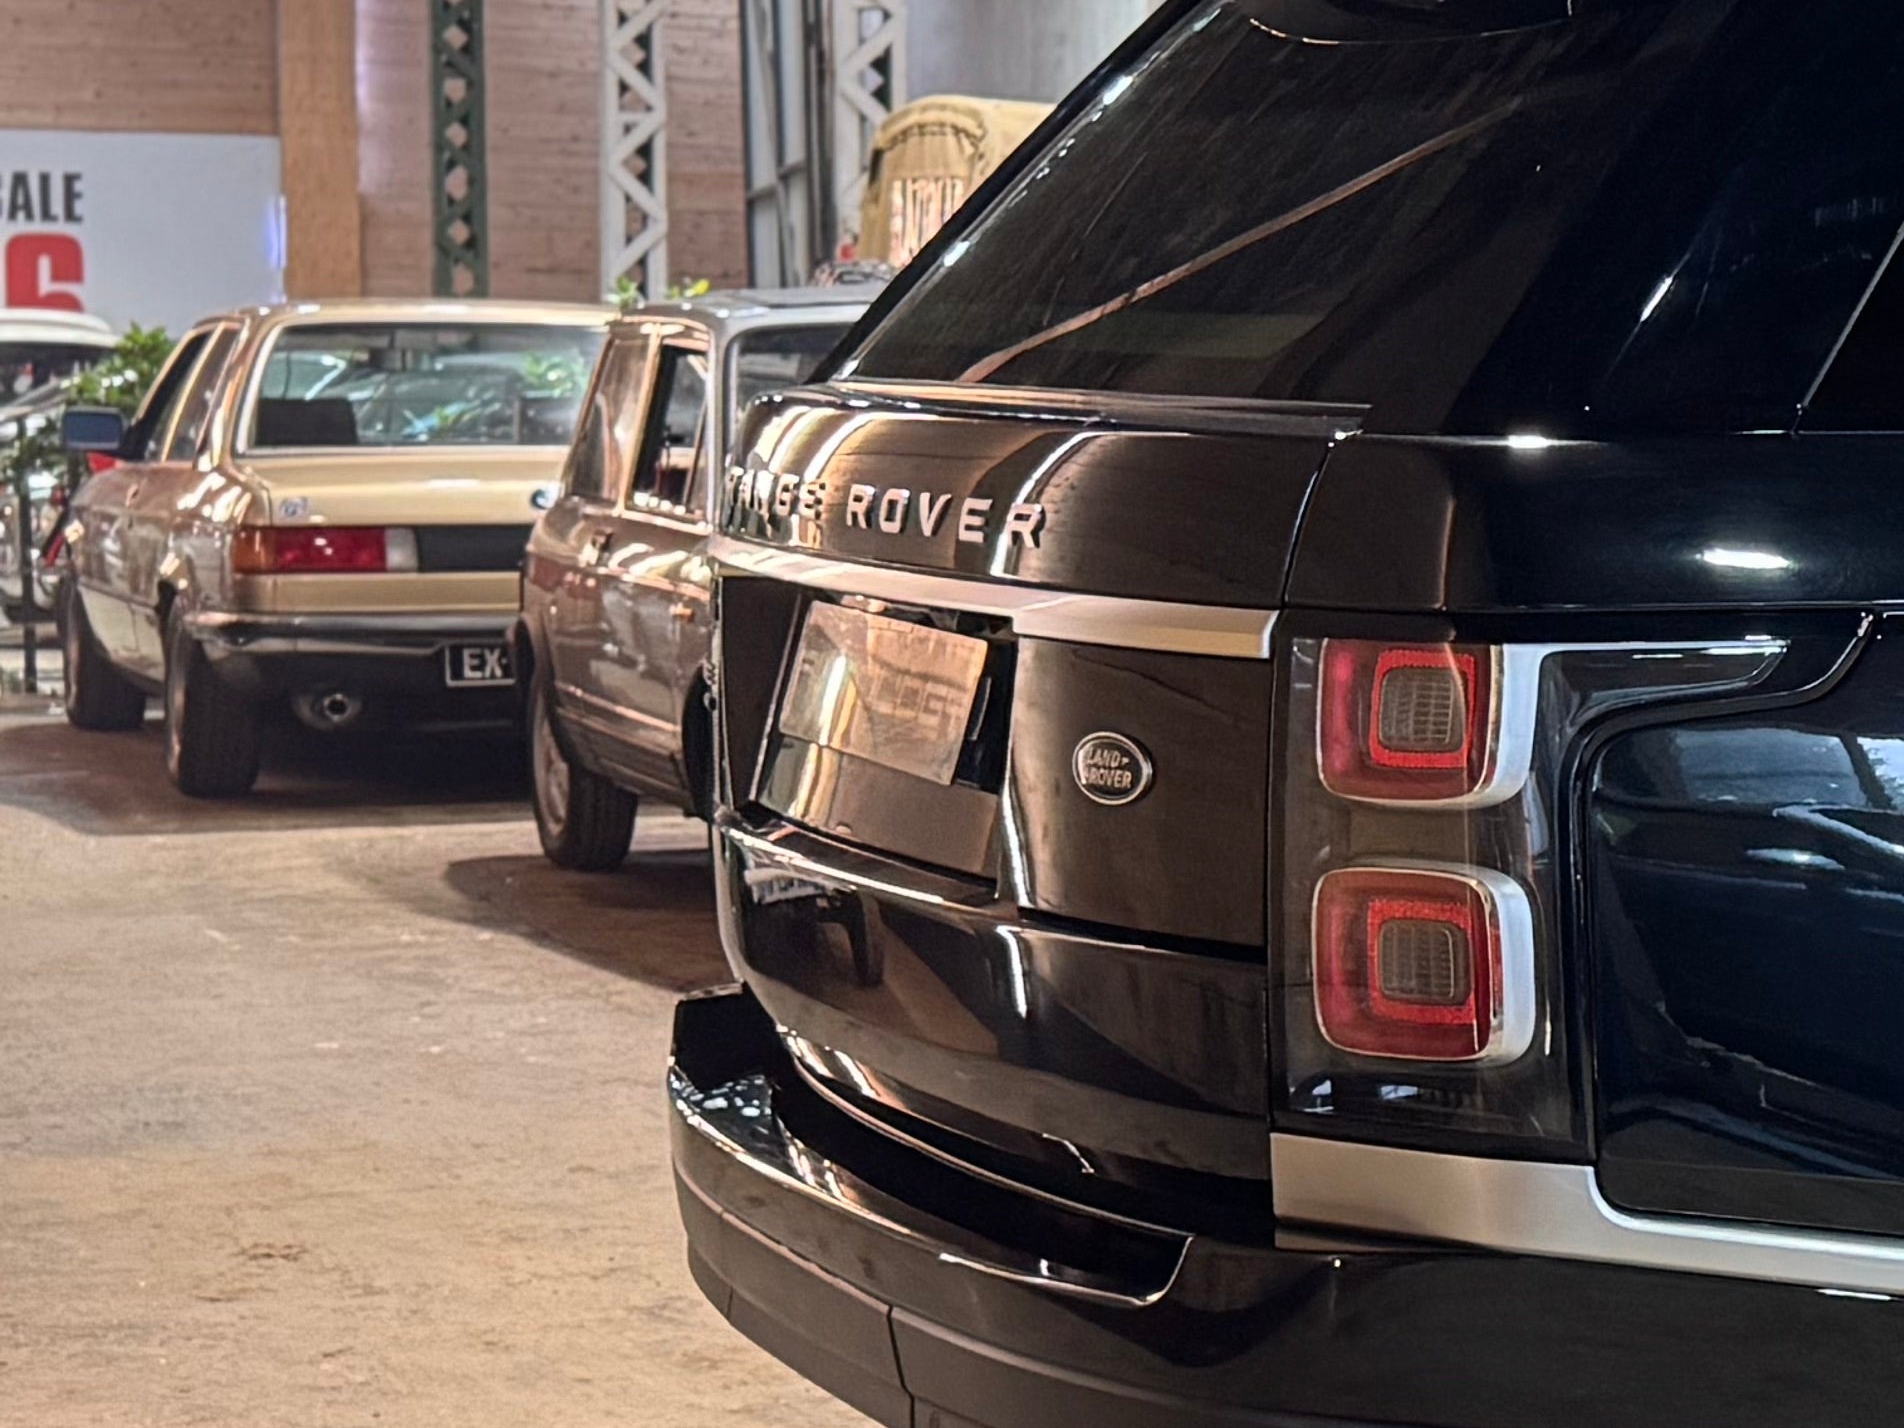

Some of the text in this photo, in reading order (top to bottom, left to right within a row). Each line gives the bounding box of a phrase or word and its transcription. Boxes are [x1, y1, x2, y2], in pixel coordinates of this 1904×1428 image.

[0, 170, 84, 223] ALE
[727, 465, 1046, 549] RANGE ROVER
[1087, 767, 1132, 789] ROVER
